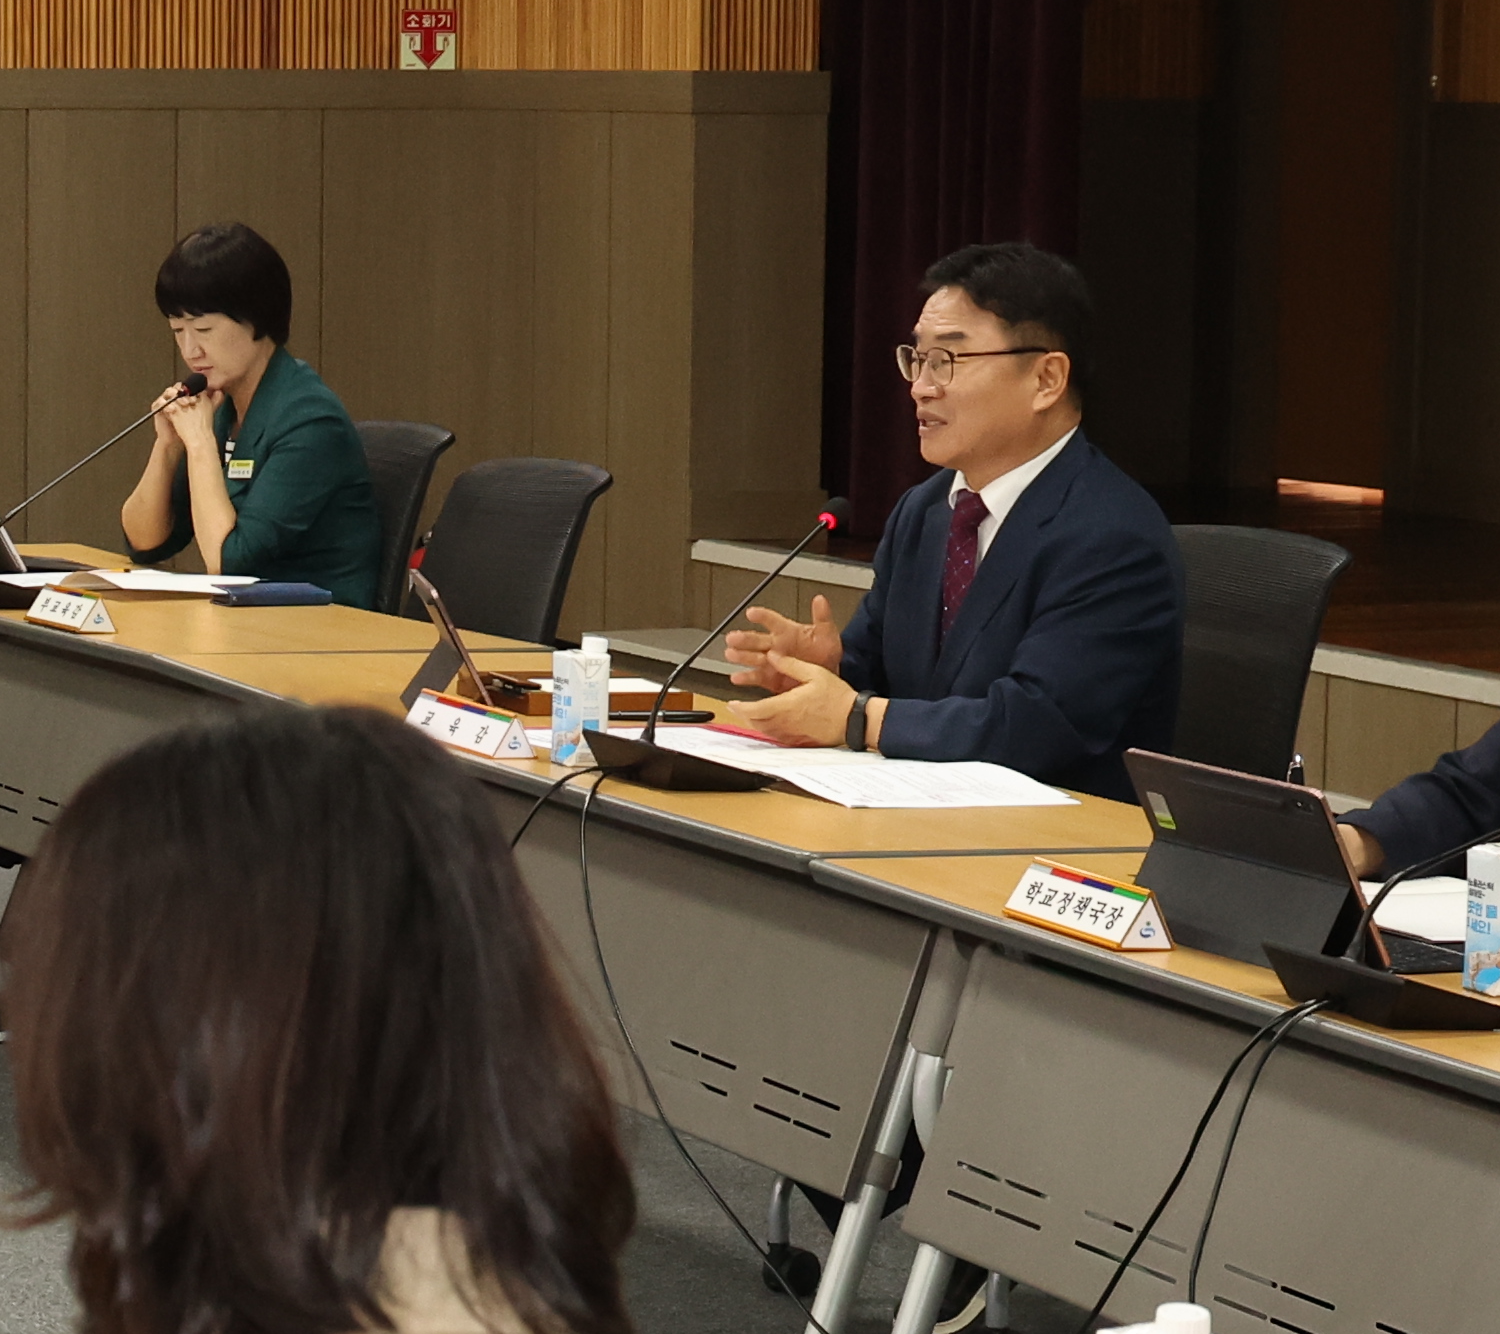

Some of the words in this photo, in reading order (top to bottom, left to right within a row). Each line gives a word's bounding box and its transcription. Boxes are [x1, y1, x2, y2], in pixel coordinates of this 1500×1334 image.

[406, 13, 452, 28] 소화기
[420, 711, 490, 744] 교육감
[1025, 880, 1124, 930] 학교정책국장
